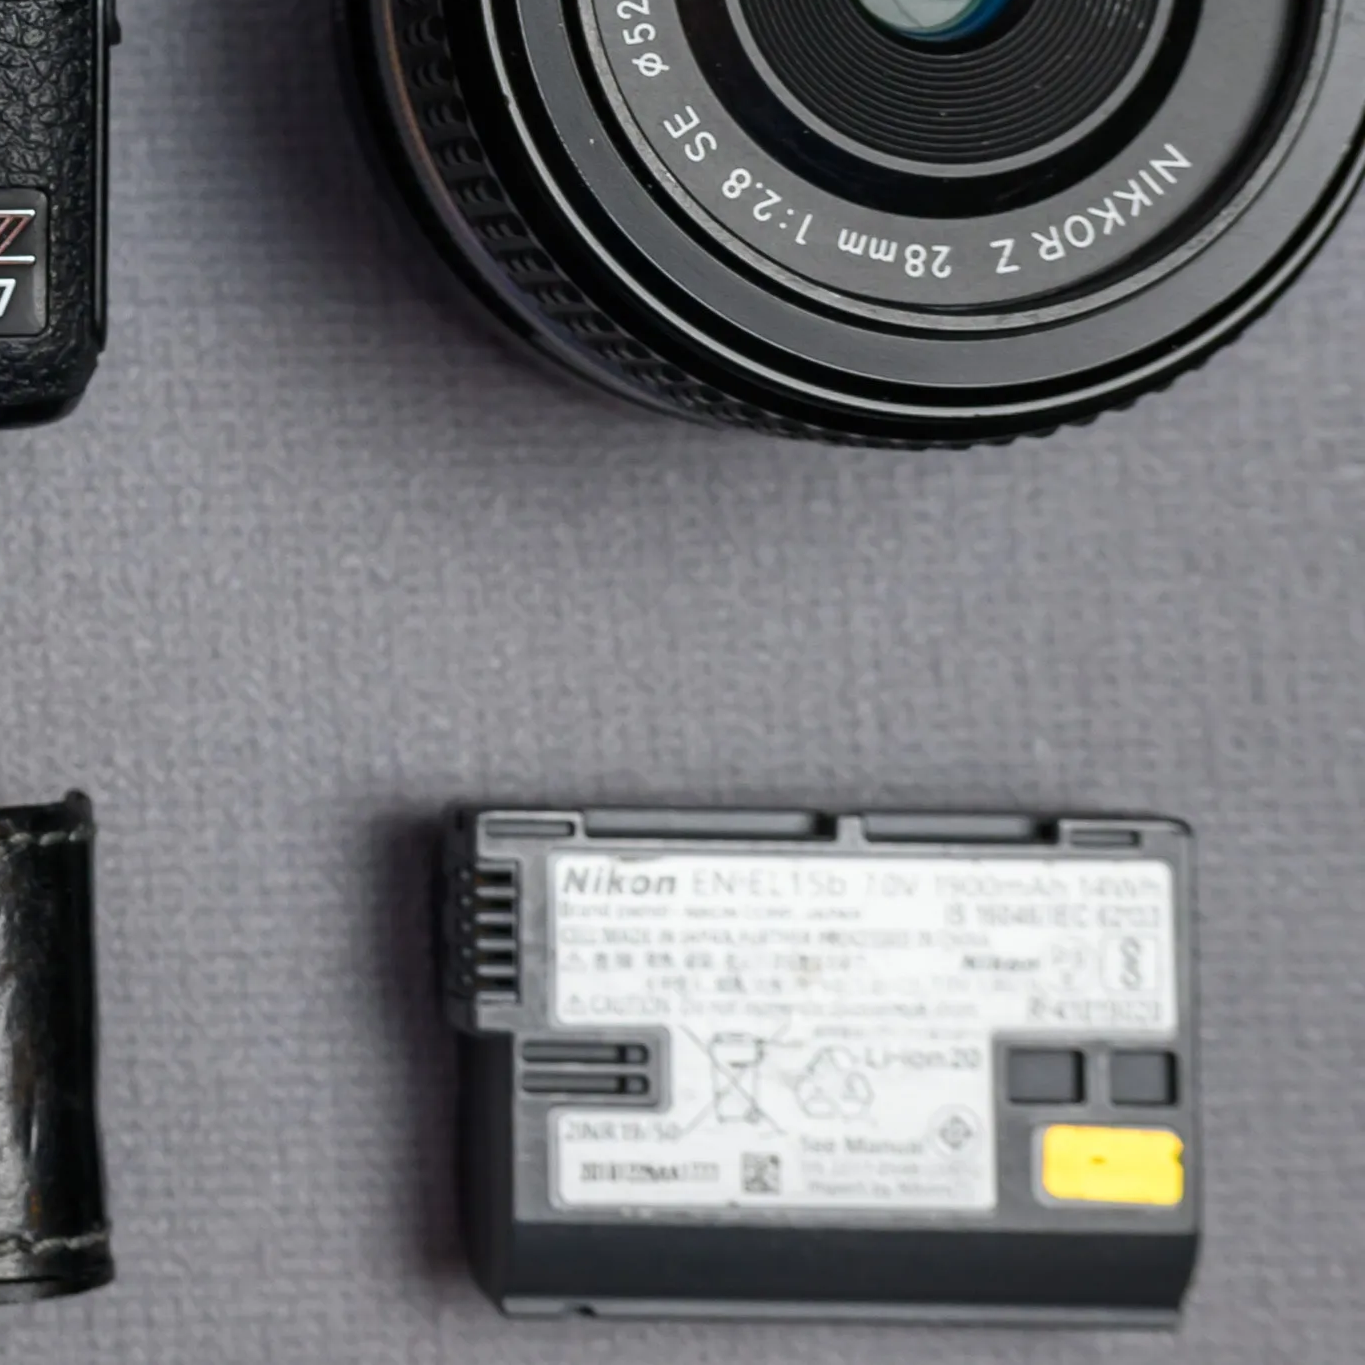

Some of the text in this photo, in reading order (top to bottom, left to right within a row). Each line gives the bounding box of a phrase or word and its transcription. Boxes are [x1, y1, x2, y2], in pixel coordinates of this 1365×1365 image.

[663, 105, 717, 162] SE
[722, 167, 813, 246] 1:2.8
[1031, 143, 1193, 262] NIKKOR
[838, 228, 953, 279] 28mm
[989, 238, 1021, 275] Z
[561, 867, 679, 896] Nikon
